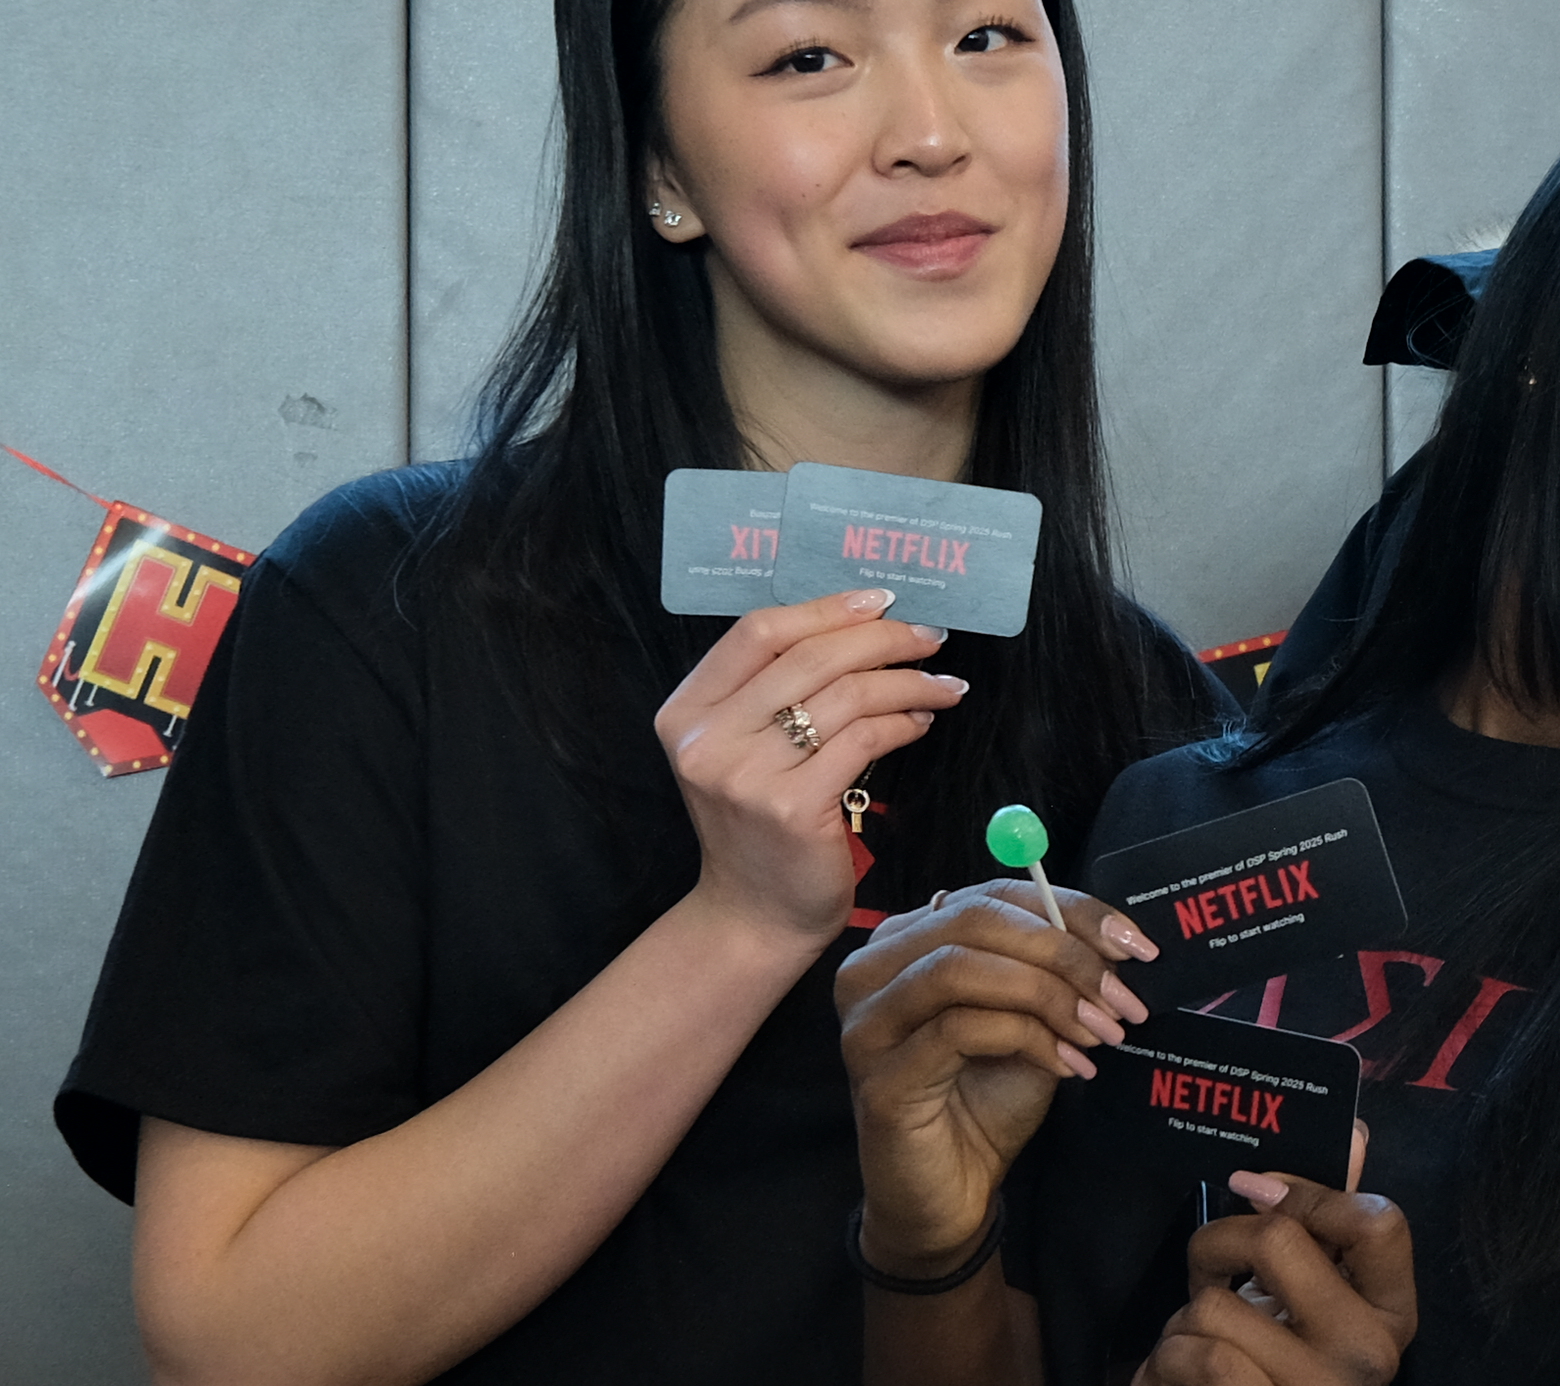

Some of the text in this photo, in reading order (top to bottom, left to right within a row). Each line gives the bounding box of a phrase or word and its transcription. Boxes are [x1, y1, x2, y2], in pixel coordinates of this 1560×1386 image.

[810, 503, 847, 516] Welcome
[849, 507, 859, 517] to
[939, 522, 967, 534] Spring
[968, 526, 989, 536] 2025
[842, 524, 971, 575] NETFLIX
[859, 567, 946, 589] Flip to start watching
[1126, 828, 1348, 906] Welcome to the premier of DSP Spring 2025 Rush
[1173, 860, 1320, 940] NETFLIX
[1209, 912, 1305, 949] Flip to start watching
[1156, 1050, 1166, 1061] to
[1167, 1052, 1183, 1064] the
[1183, 1056, 1218, 1072] premier
[1219, 1063, 1229, 1074] of
[1229, 1066, 1250, 1078] DSP
[1251, 1070, 1280, 1088] Spring
[1281, 1077, 1305, 1090] 2025
[1305, 1082, 1329, 1095] Rush
[1149, 1068, 1285, 1134] NETFLIX
[1168, 1117, 1260, 1148] Flip to start watching
